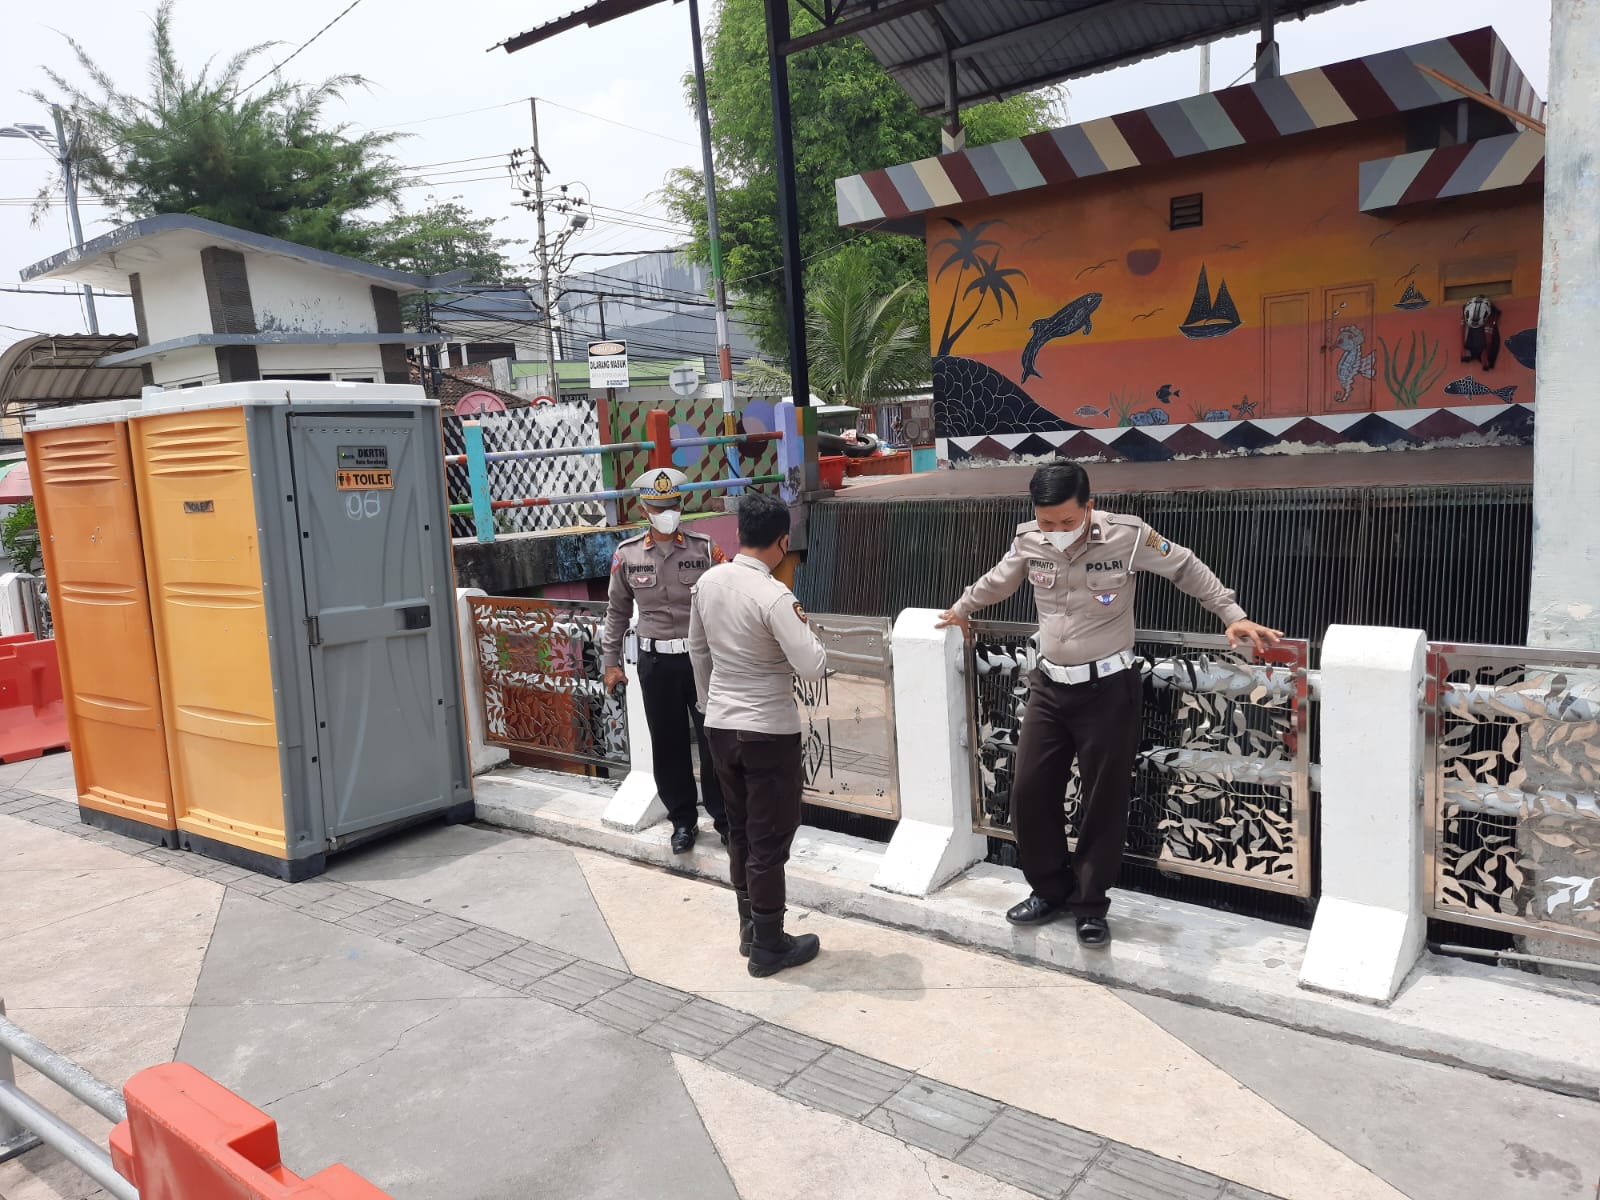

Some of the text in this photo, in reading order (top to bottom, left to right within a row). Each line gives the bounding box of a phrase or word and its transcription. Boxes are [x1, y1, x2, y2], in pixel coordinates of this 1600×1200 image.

[353, 473, 391, 486] TOILET
[678, 560, 704, 569] POLRI
[1085, 560, 1123, 572] POLRI
